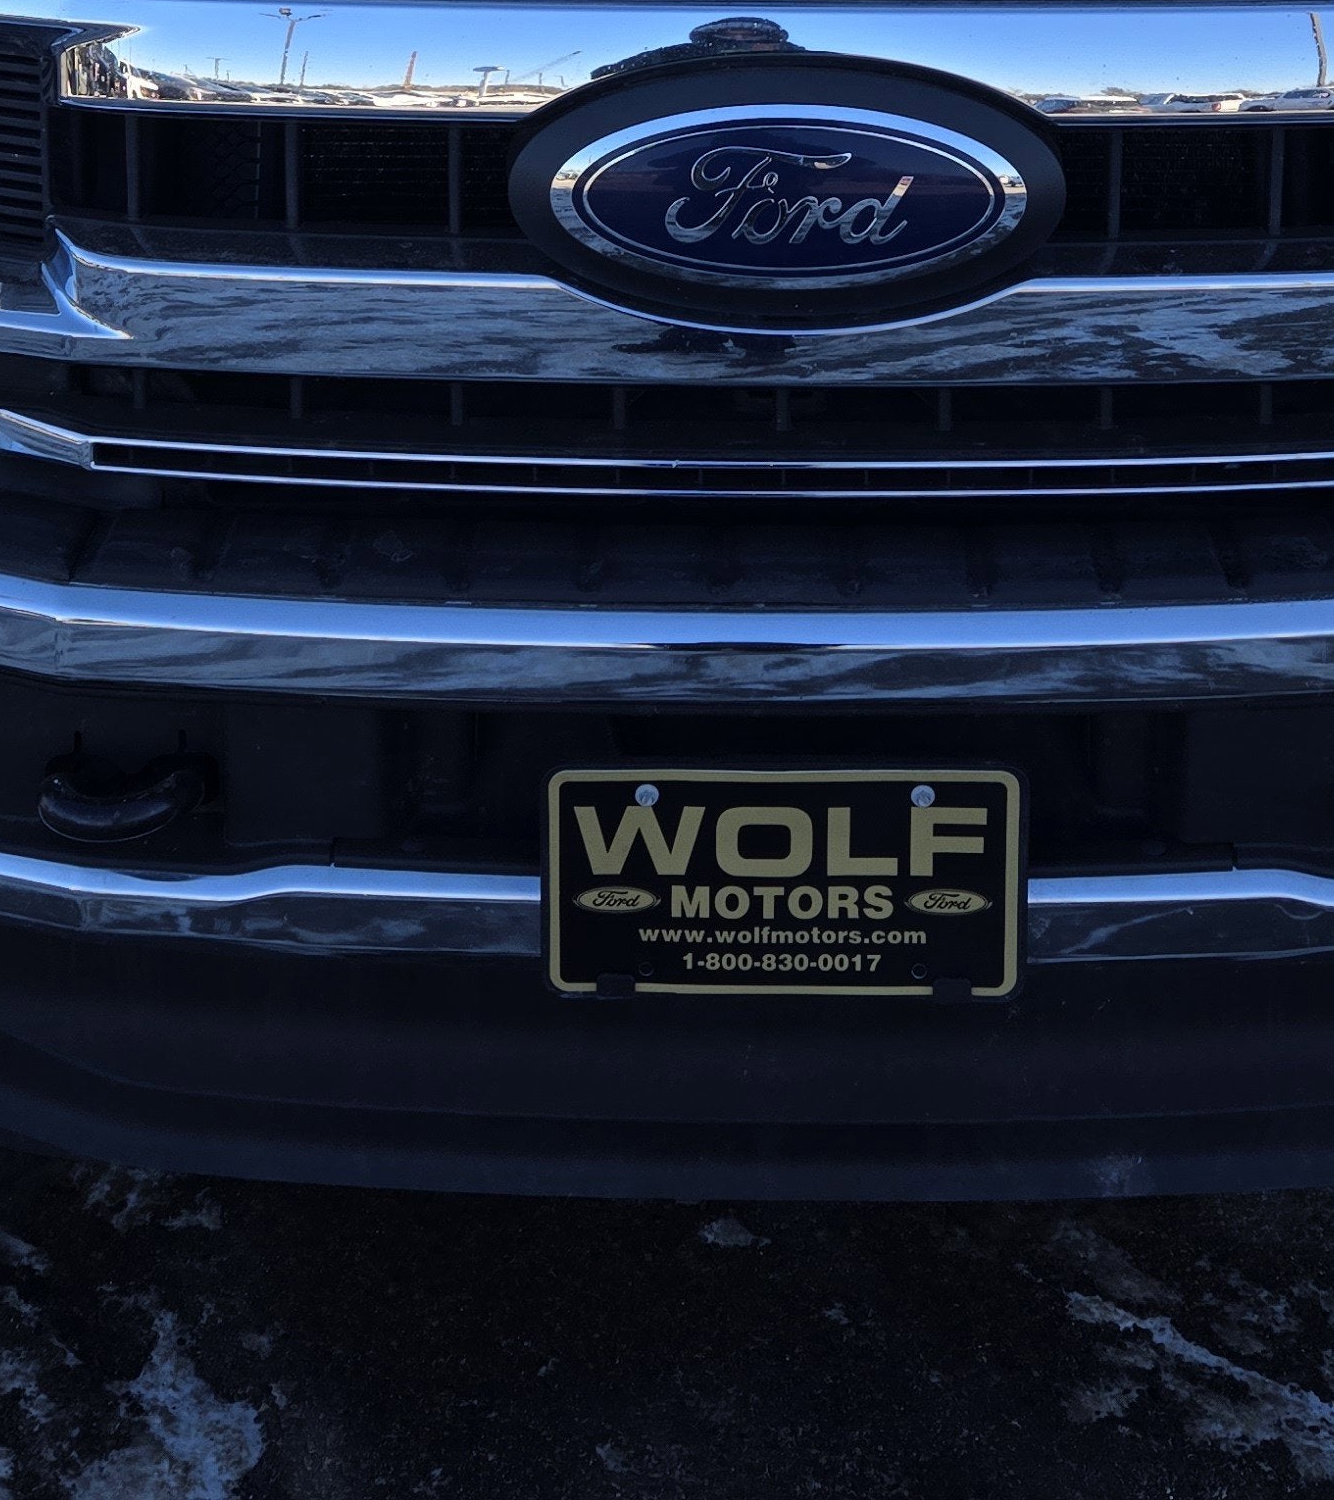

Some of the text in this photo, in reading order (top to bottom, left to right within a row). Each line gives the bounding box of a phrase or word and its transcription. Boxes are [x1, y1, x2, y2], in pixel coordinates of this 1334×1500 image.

[665, 145, 915, 246] Ford
[573, 805, 988, 878] WOLF
[592, 884, 972, 920] Ford MOTORS Ford
[638, 926, 927, 945] www.wolfmotors.com
[682, 952, 882, 972] 1-800-830-0017
